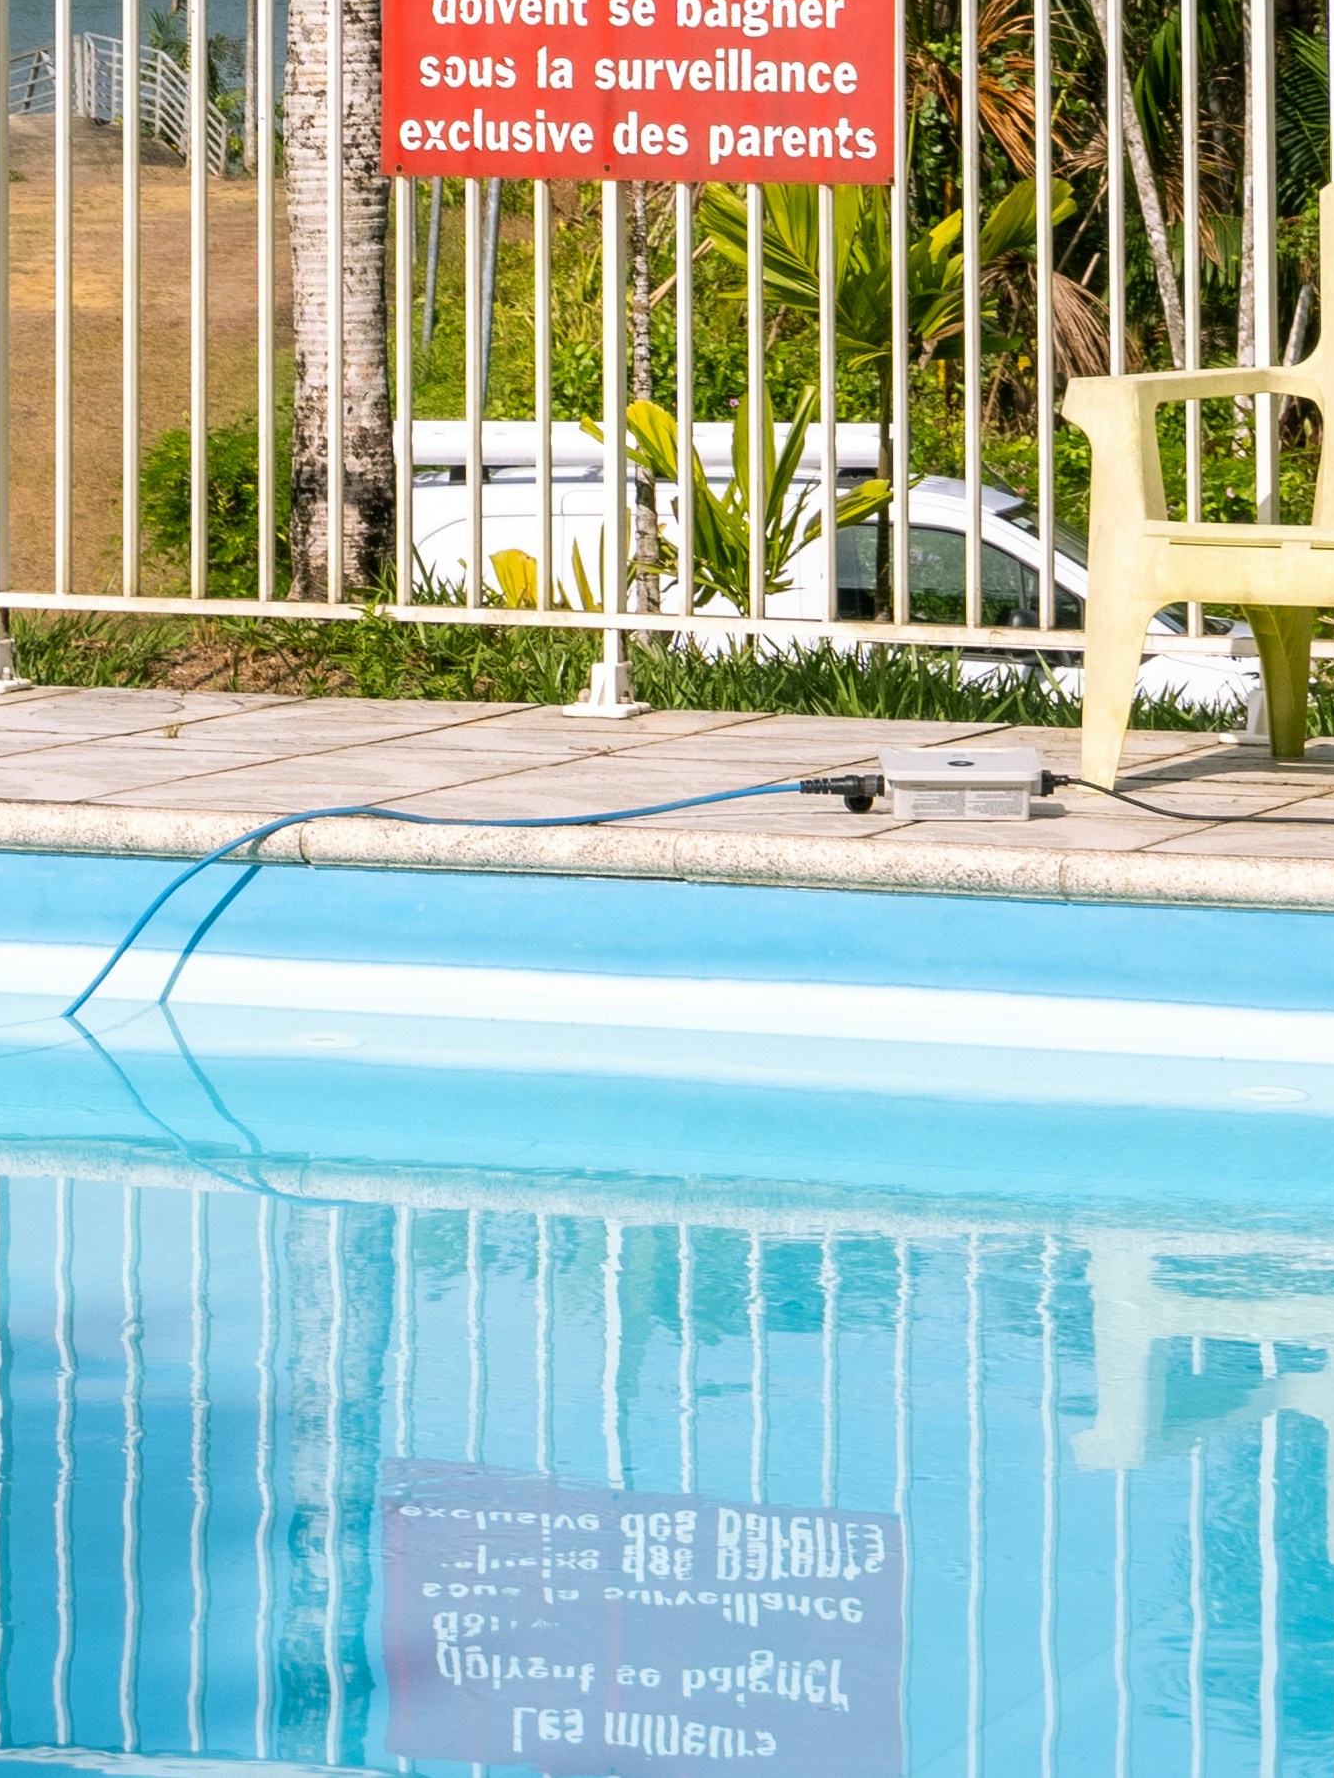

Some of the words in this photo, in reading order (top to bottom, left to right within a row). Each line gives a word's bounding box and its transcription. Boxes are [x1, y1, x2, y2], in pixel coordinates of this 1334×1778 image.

[420, 55, 516, 88] sous
[537, 46, 573, 90] la
[595, 48, 857, 94] surveillance
[399, 109, 594, 153] exclusive
[613, 111, 688, 156] des
[709, 118, 877, 165] parents
